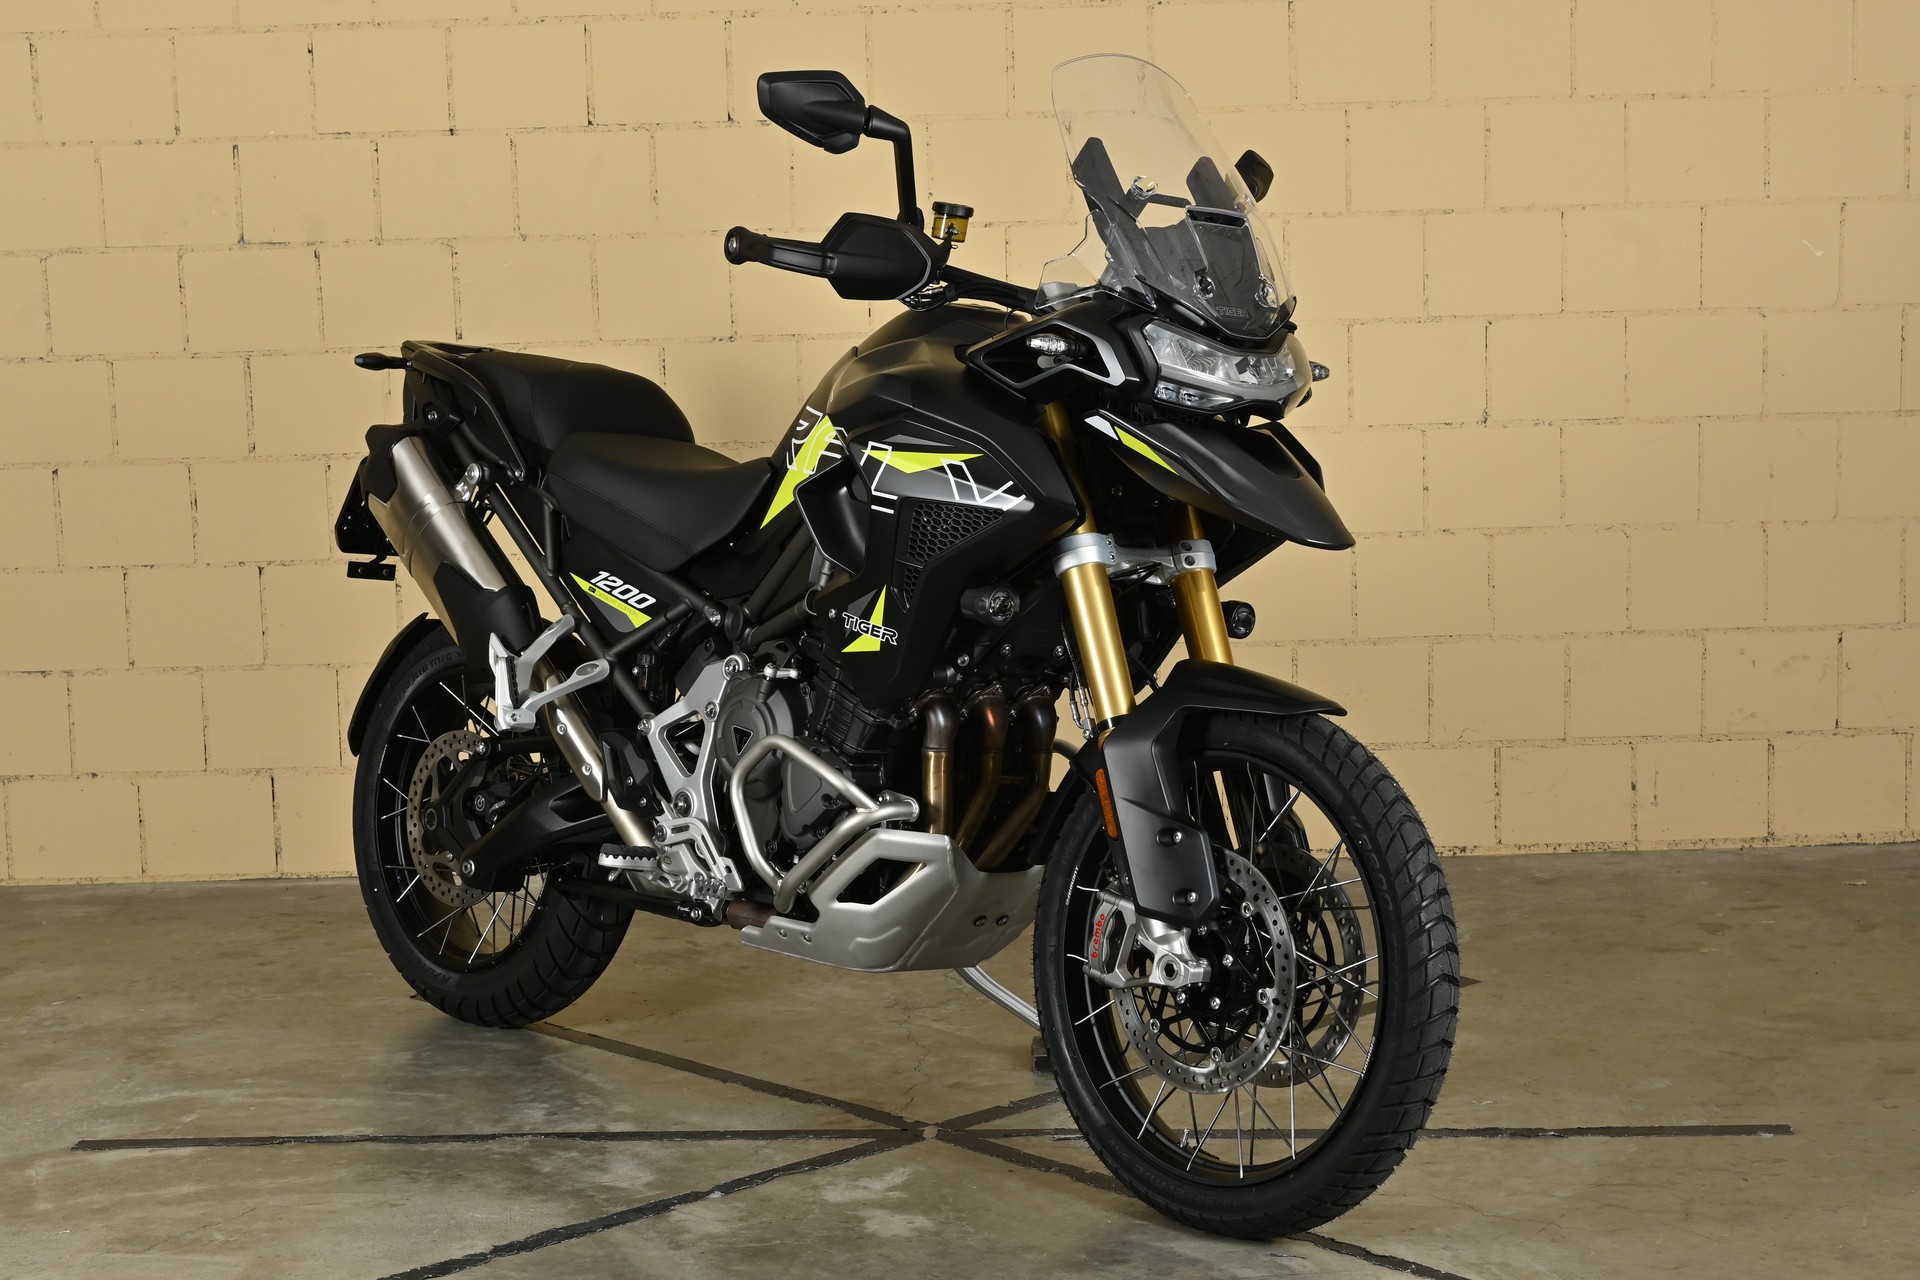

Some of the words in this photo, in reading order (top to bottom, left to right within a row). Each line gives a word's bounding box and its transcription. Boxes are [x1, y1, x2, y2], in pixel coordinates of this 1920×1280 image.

[1216, 306, 1250, 319] TIGER
[590, 571, 657, 609] 1200
[842, 612, 898, 645] TIGER
[1091, 913, 1105, 959] brembo
